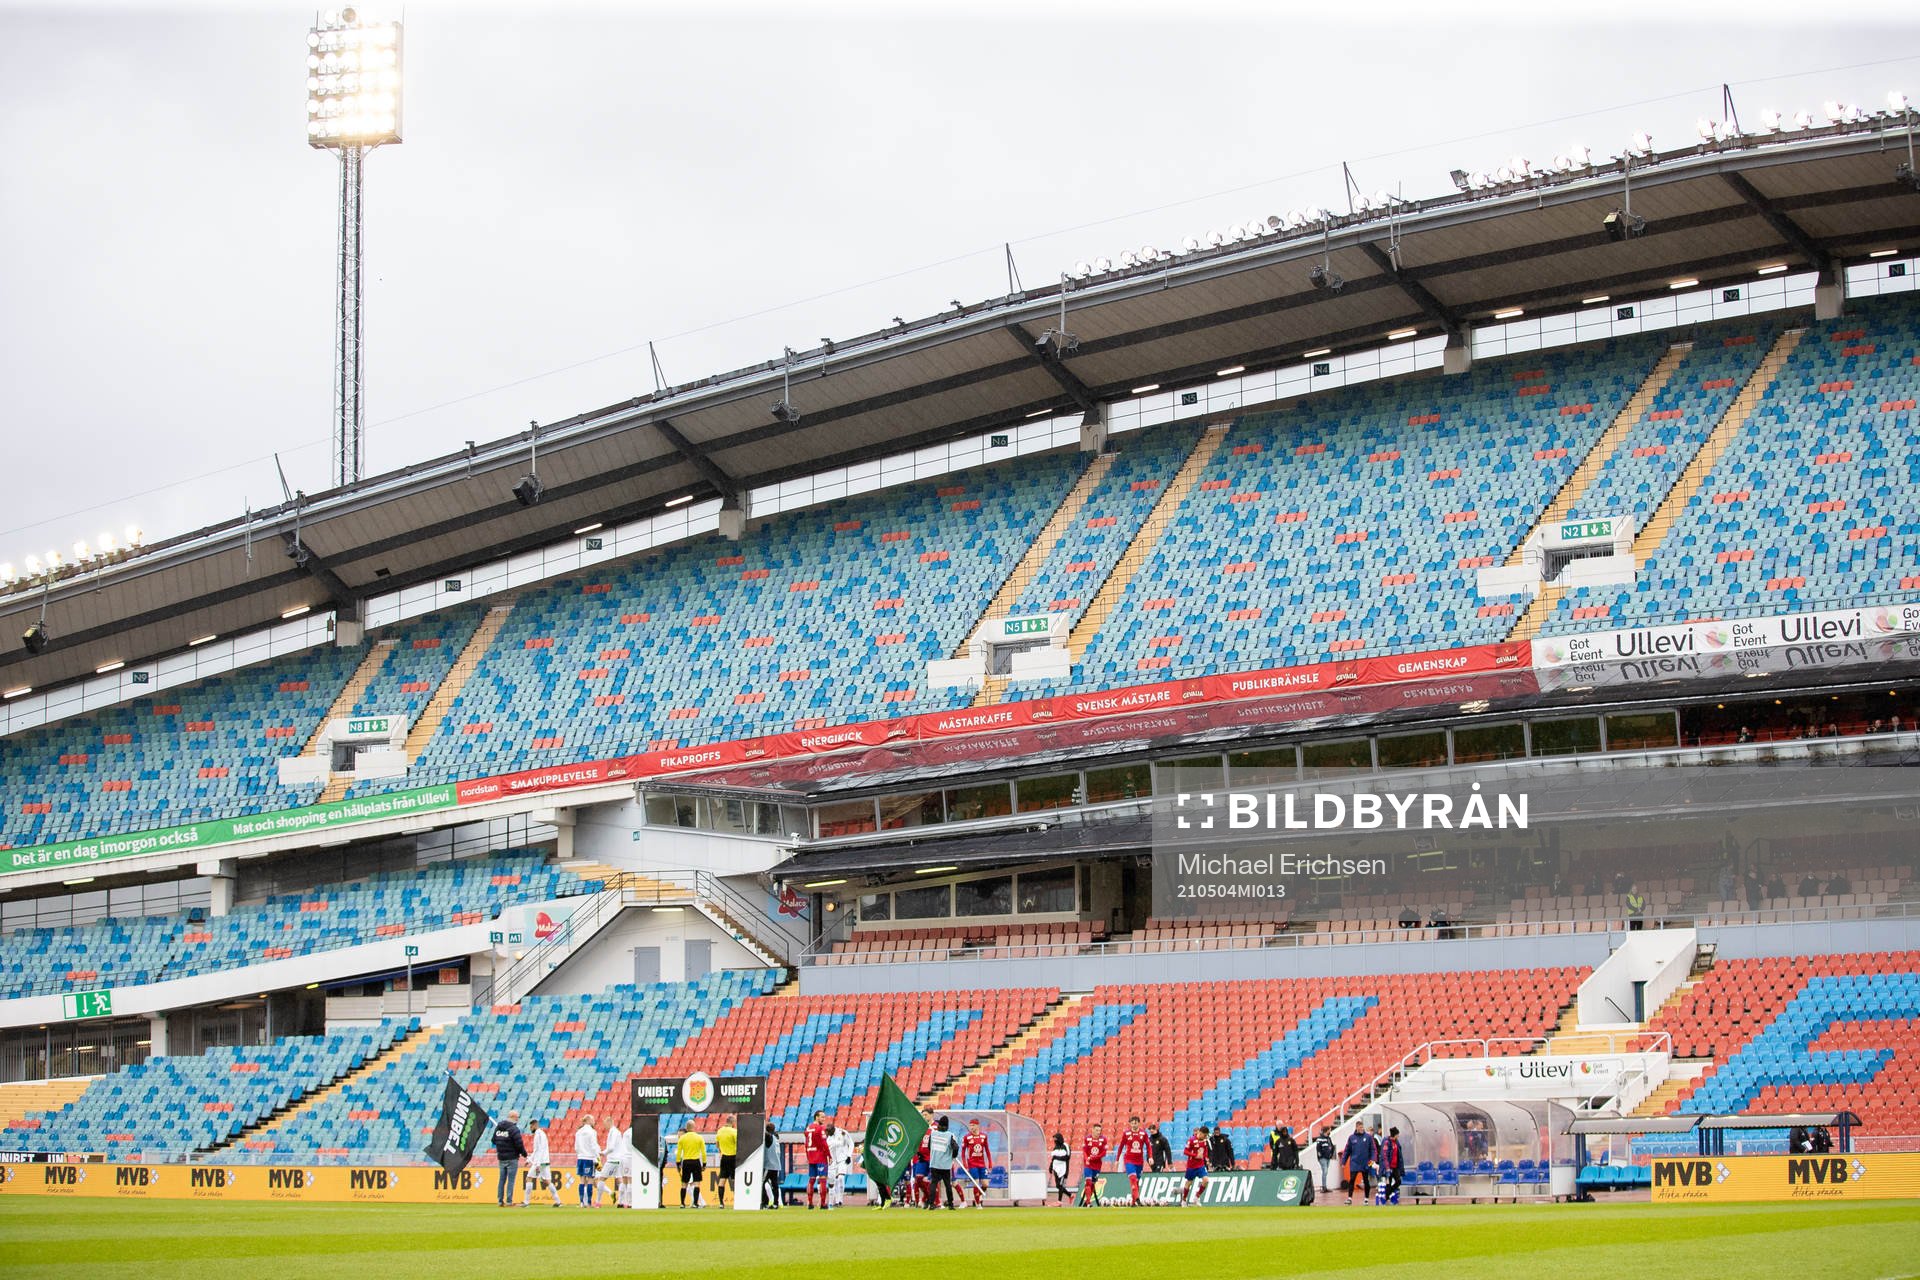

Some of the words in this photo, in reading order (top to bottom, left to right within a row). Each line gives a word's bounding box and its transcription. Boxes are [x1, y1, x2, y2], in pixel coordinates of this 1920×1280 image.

[1724, 290, 1739, 300] N2
[1618, 308, 1633, 318] N3
[1314, 364, 1329, 374] N4
[1183, 394, 1197, 404] N5
[992, 437, 1006, 446] N6
[1563, 527, 1579, 538] N2
[587, 540, 601, 548] N7
[1903, 607, 1920, 619] Go
[1006, 622, 1020, 633] N5
[1732, 623, 1753, 635] Got
[1781, 612, 1861, 642] Ullevi
[1904, 620, 1920, 630] Ev
[1569, 638, 1590, 650] Got
[1616, 627, 1694, 657] Ullevi
[1734, 634, 1767, 647] Event
[1570, 649, 1603, 662] Event
[1397, 656, 1467, 674] GEMENSKAP
[134, 673, 147, 682] N9
[1232, 673, 1319, 692] PUBLIKBRÄNSLE
[1076, 698, 1118, 713] SVENSK
[1121, 690, 1171, 706] MÄSTARE
[349, 722, 363, 732] N8
[938, 711, 1013, 731] MÄSTARKAFFE
[801, 731, 863, 747] ENERGIKICK
[660, 751, 721, 767] FIKAPROFFS
[511, 769, 598, 790] SMAKUPPLEVELSE
[461, 783, 498, 797] nordstan
[233, 822, 254, 835] Mat
[255, 818, 274, 831] och
[276, 811, 327, 829] shopping
[328, 809, 342, 820] en
[344, 801, 391, 818] hållplats
[392, 795, 416, 811] från
[418, 790, 450, 806] Ullevi
[12, 851, 35, 866] Det
[38, 848, 51, 862] är
[54, 849, 71, 860] en
[73, 843, 99, 859] dag
[100, 836, 156, 854] imorgon
[159, 827, 199, 847] också
[510, 934, 520, 943] M1
[1520, 1060, 1573, 1078] Ullevi
[637, 1086, 676, 1098] UNIBET
[720, 1084, 758, 1096] UNIBET
[45, 1166, 77, 1184] MVB
[116, 1167, 149, 1186] MVB
[191, 1168, 225, 1187] MVB
[269, 1169, 304, 1188] MVB
[641, 1171, 650, 1186] U
[1654, 1161, 1713, 1187] MVB
[1788, 1158, 1848, 1184] MVB
[350, 1169, 387, 1189] MVB
[744, 1171, 753, 1187] U
